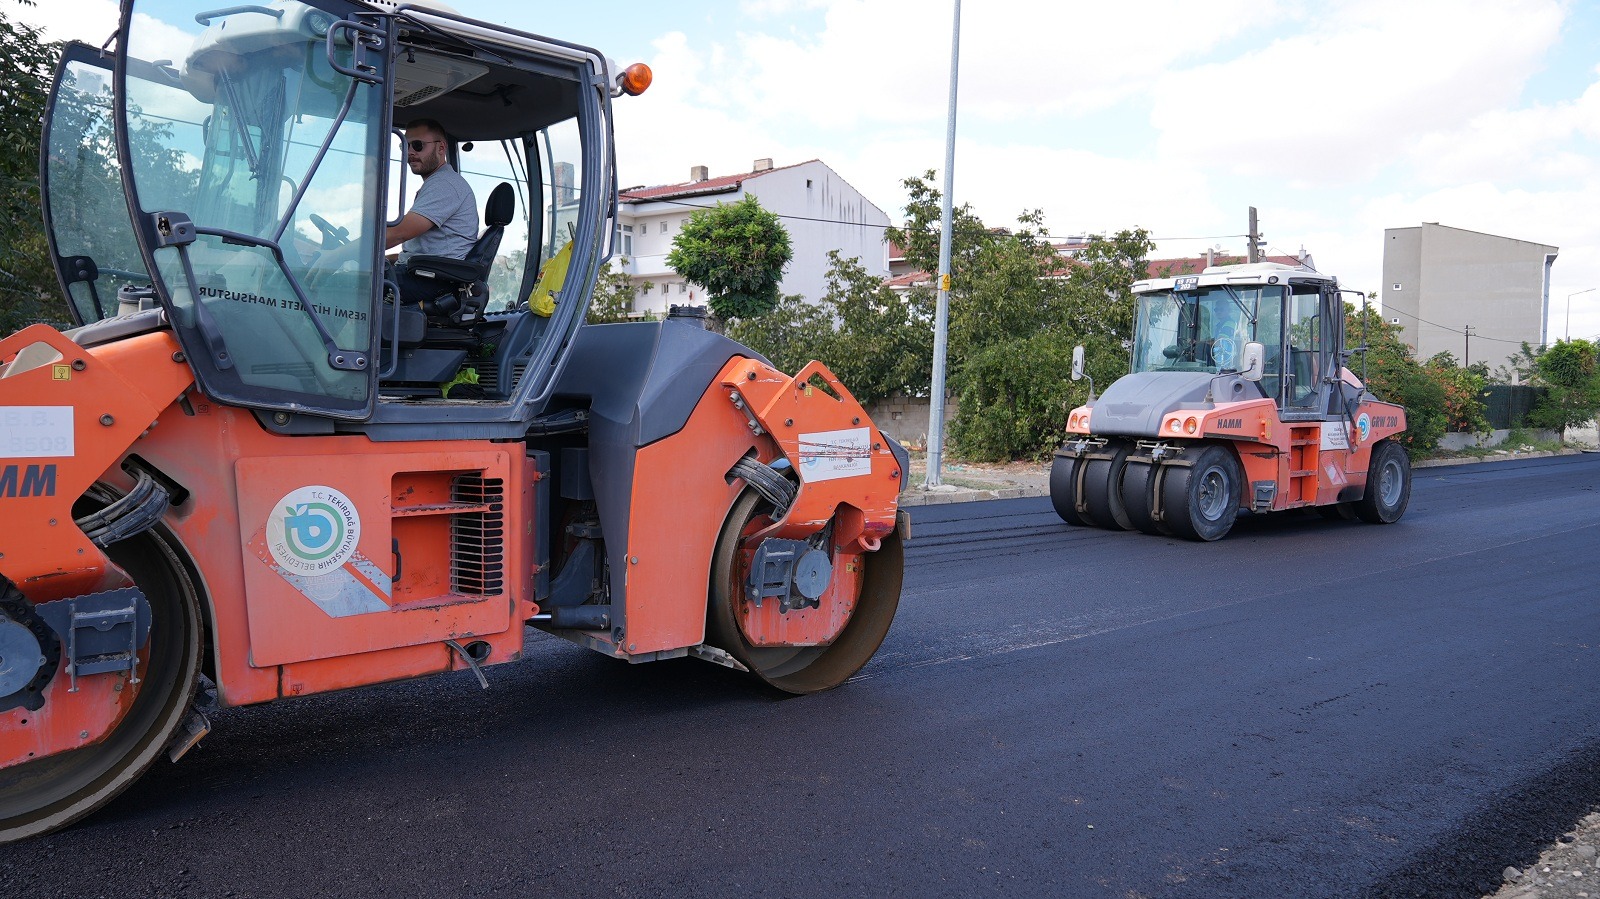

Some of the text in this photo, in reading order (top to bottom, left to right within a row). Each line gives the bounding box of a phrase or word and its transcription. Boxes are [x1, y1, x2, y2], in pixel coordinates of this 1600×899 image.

[1217, 419, 1242, 428] HAMM
[1371, 416, 1398, 427] GRW 280
[275, 491, 356, 571] T.C. TEKİRDAĞ BÜYÜKŞEHİR BELEDİYESİ
